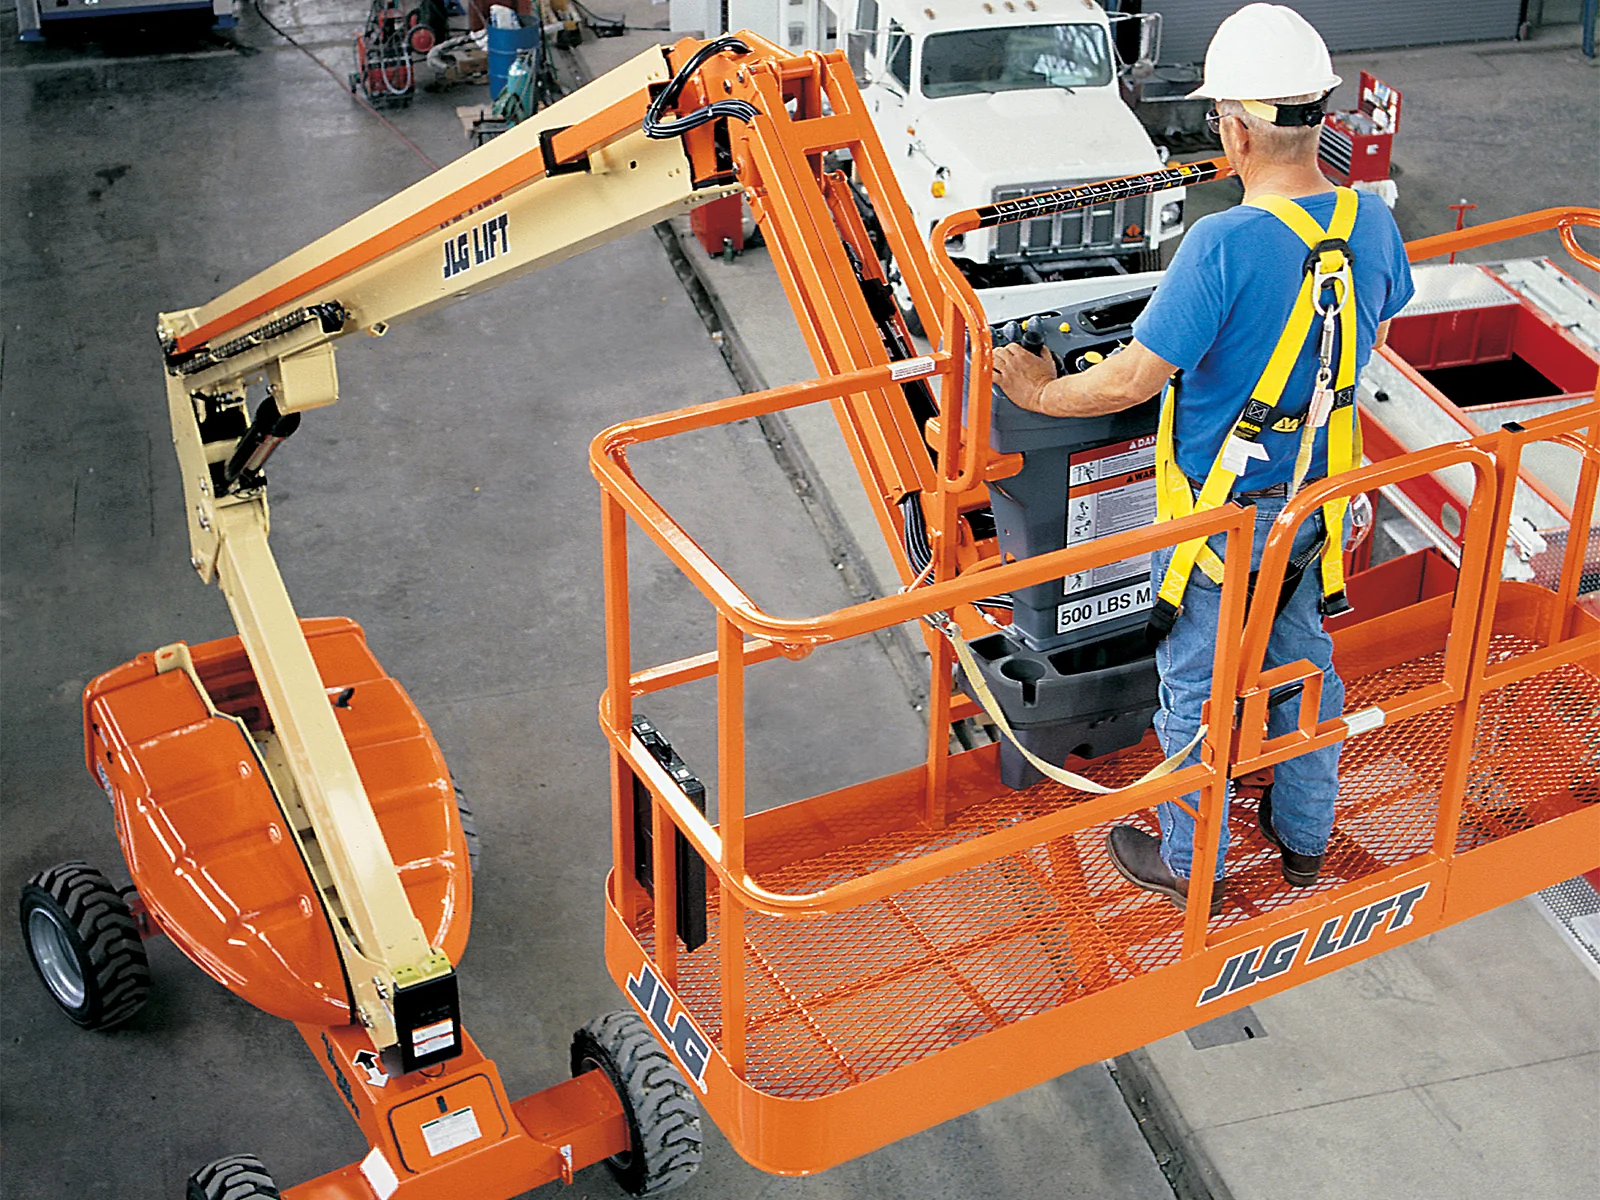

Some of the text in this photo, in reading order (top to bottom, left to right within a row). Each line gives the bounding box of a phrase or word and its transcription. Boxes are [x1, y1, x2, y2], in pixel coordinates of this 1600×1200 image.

[443, 232, 470, 279] JLG
[472, 213, 509, 265] LIFT
[1137, 435, 1157, 448] DAN
[1061, 604, 1092, 625] 500
[1097, 593, 1131, 615] LBS
[1196, 882, 1430, 1007] JLG LIFT
[625, 961, 712, 1086] JLG
